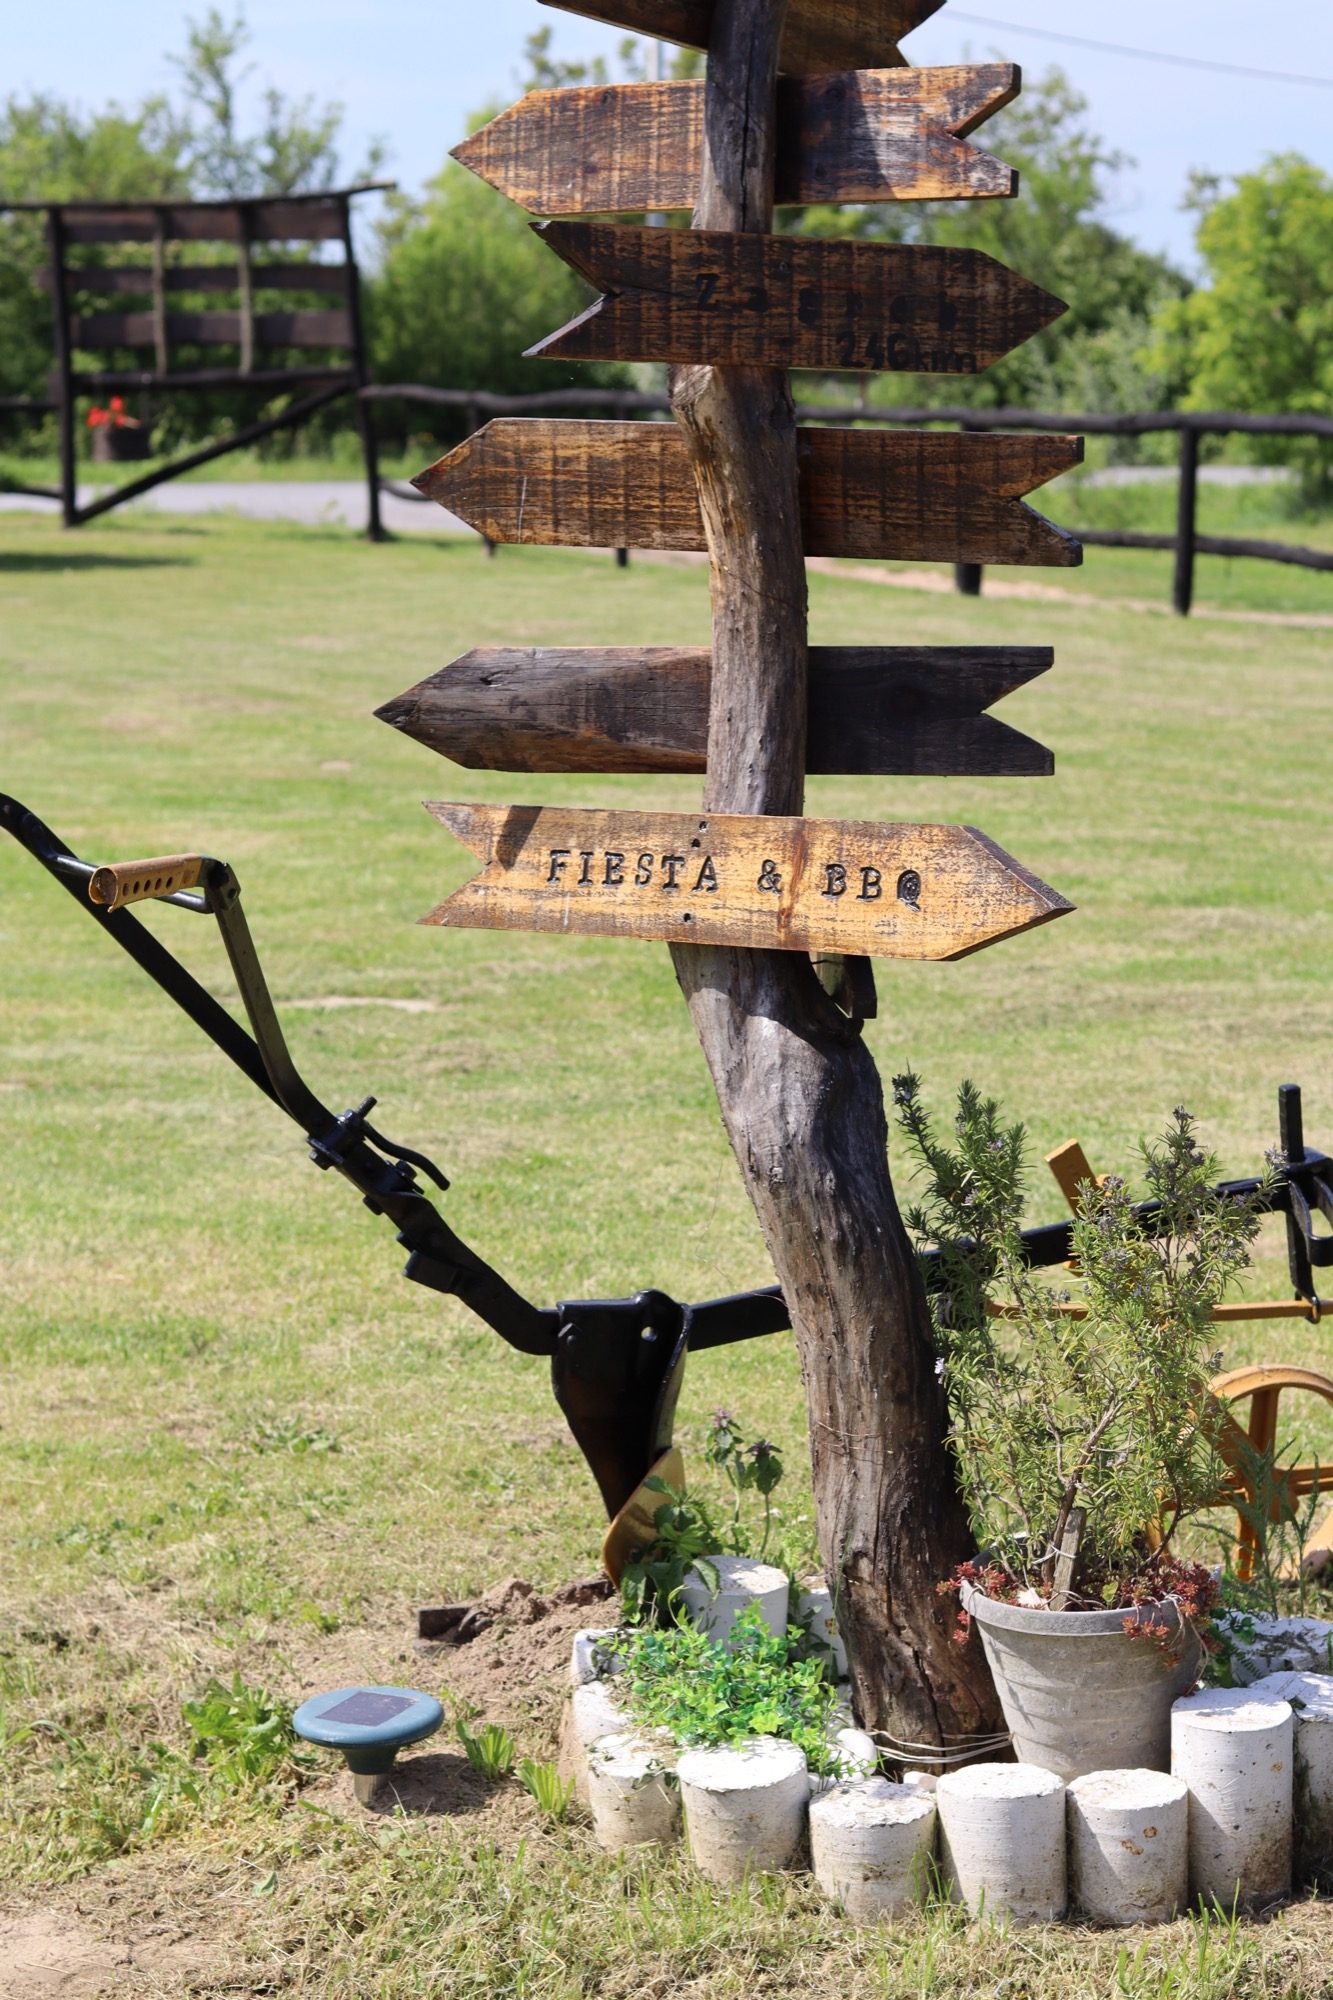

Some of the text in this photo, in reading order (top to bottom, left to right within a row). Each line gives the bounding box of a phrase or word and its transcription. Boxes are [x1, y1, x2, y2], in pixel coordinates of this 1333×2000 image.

[546, 849, 922, 913] FIESTA & BBQ
